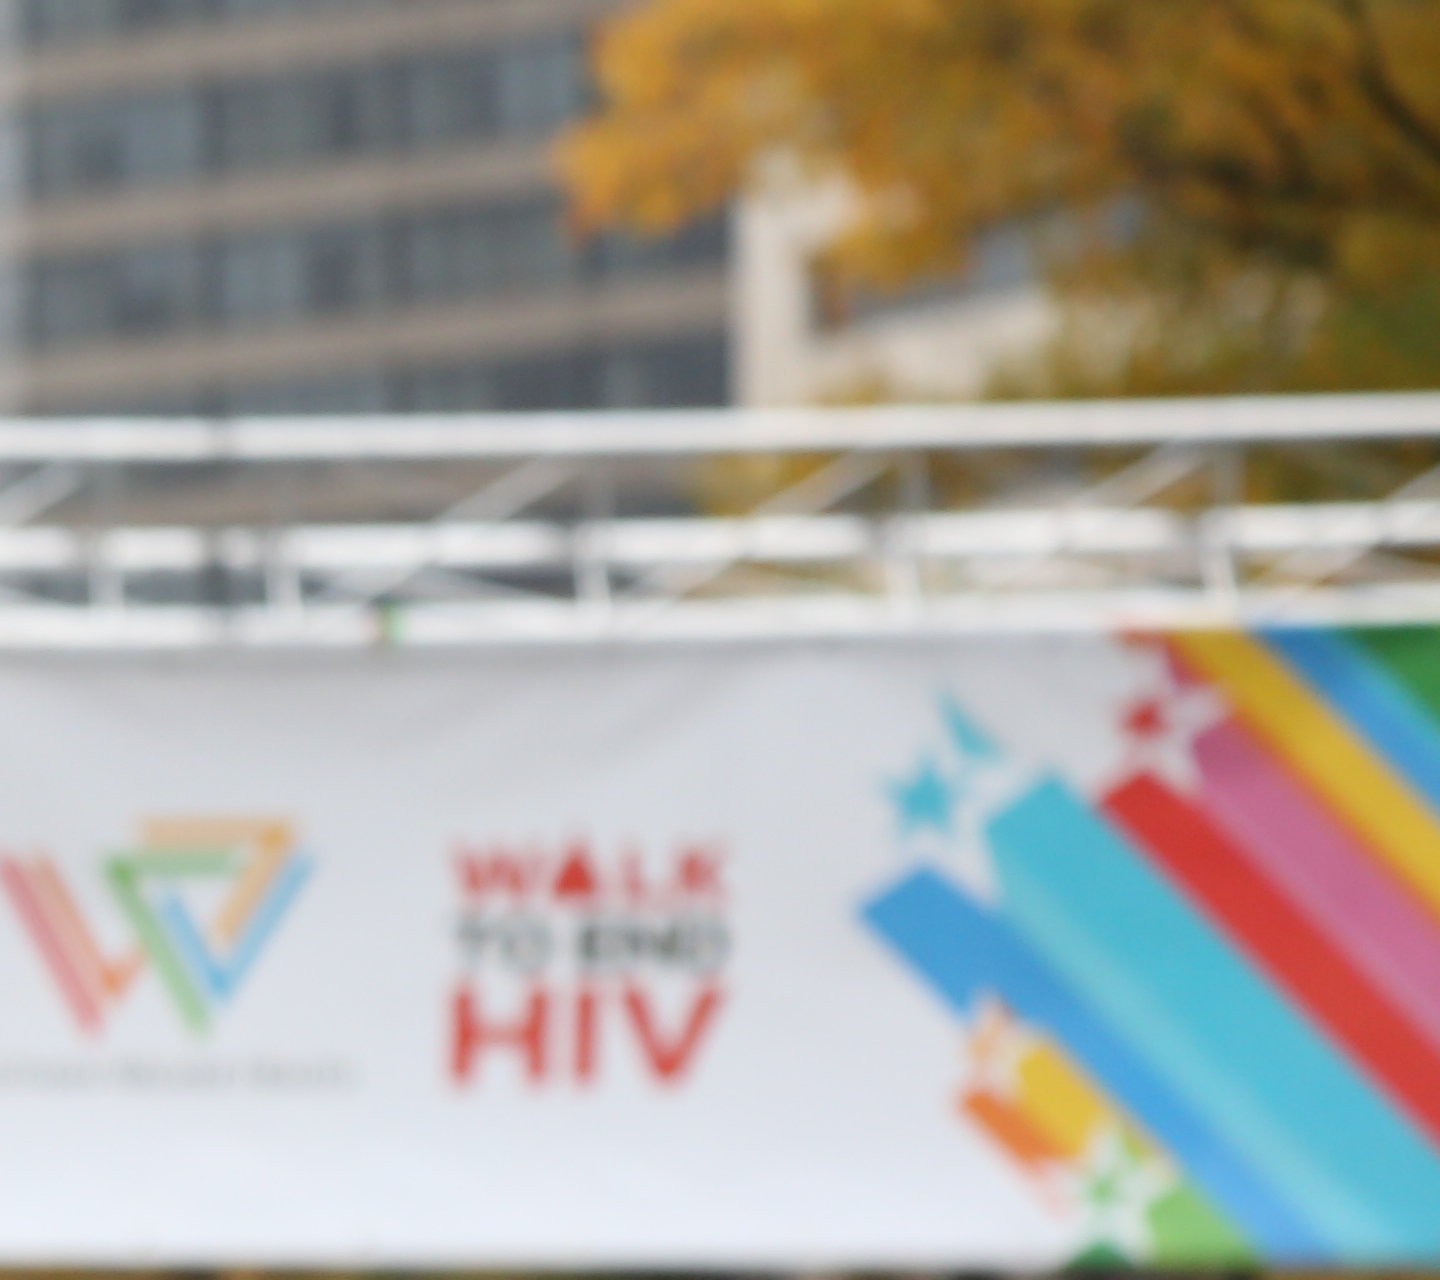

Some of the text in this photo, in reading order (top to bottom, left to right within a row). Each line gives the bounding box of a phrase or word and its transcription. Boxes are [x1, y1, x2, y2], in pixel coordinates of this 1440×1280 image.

[450, 838, 728, 902] WALK
[454, 914, 731, 974] TO END
[447, 986, 728, 1085] HIV
